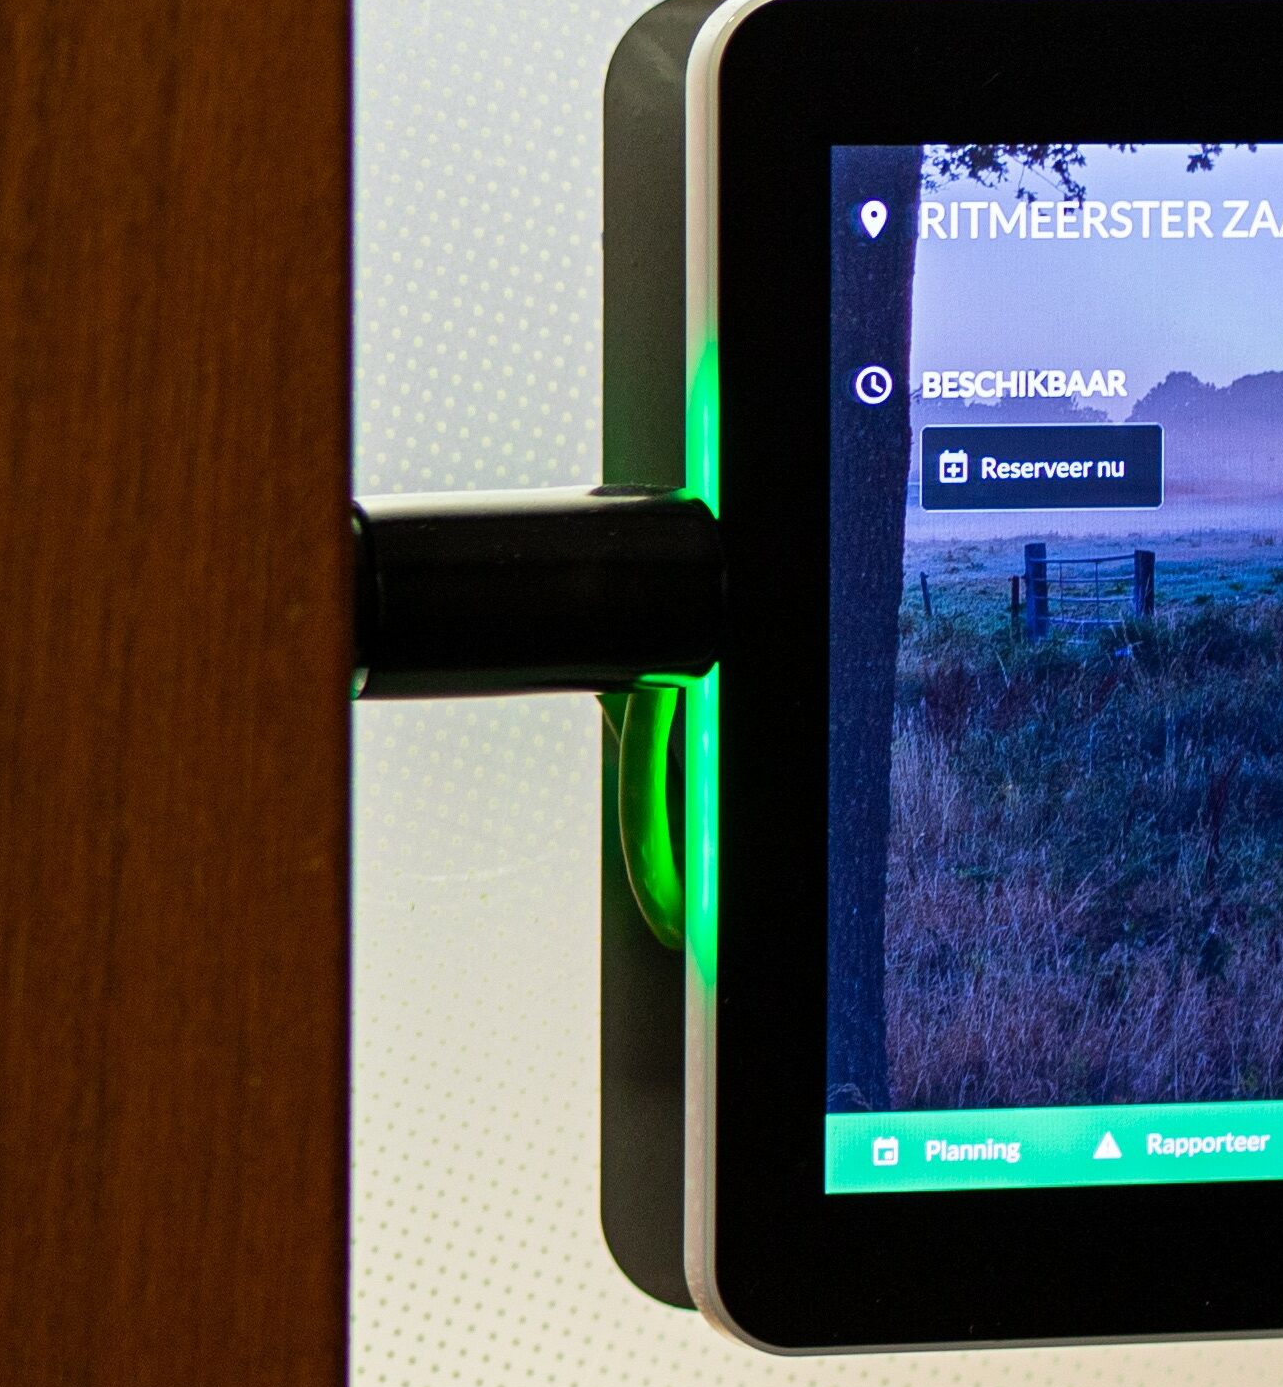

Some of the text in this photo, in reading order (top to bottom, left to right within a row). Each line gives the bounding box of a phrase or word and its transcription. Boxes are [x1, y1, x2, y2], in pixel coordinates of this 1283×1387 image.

[919, 200, 1214, 240] RITMEERSTER
[922, 370, 1127, 399] BESCHIKBAAR
[981, 456, 1125, 480] Reserveer nu
[926, 1138, 1021, 1163] Planning
[1147, 1132, 1270, 1157] Rapporteer
